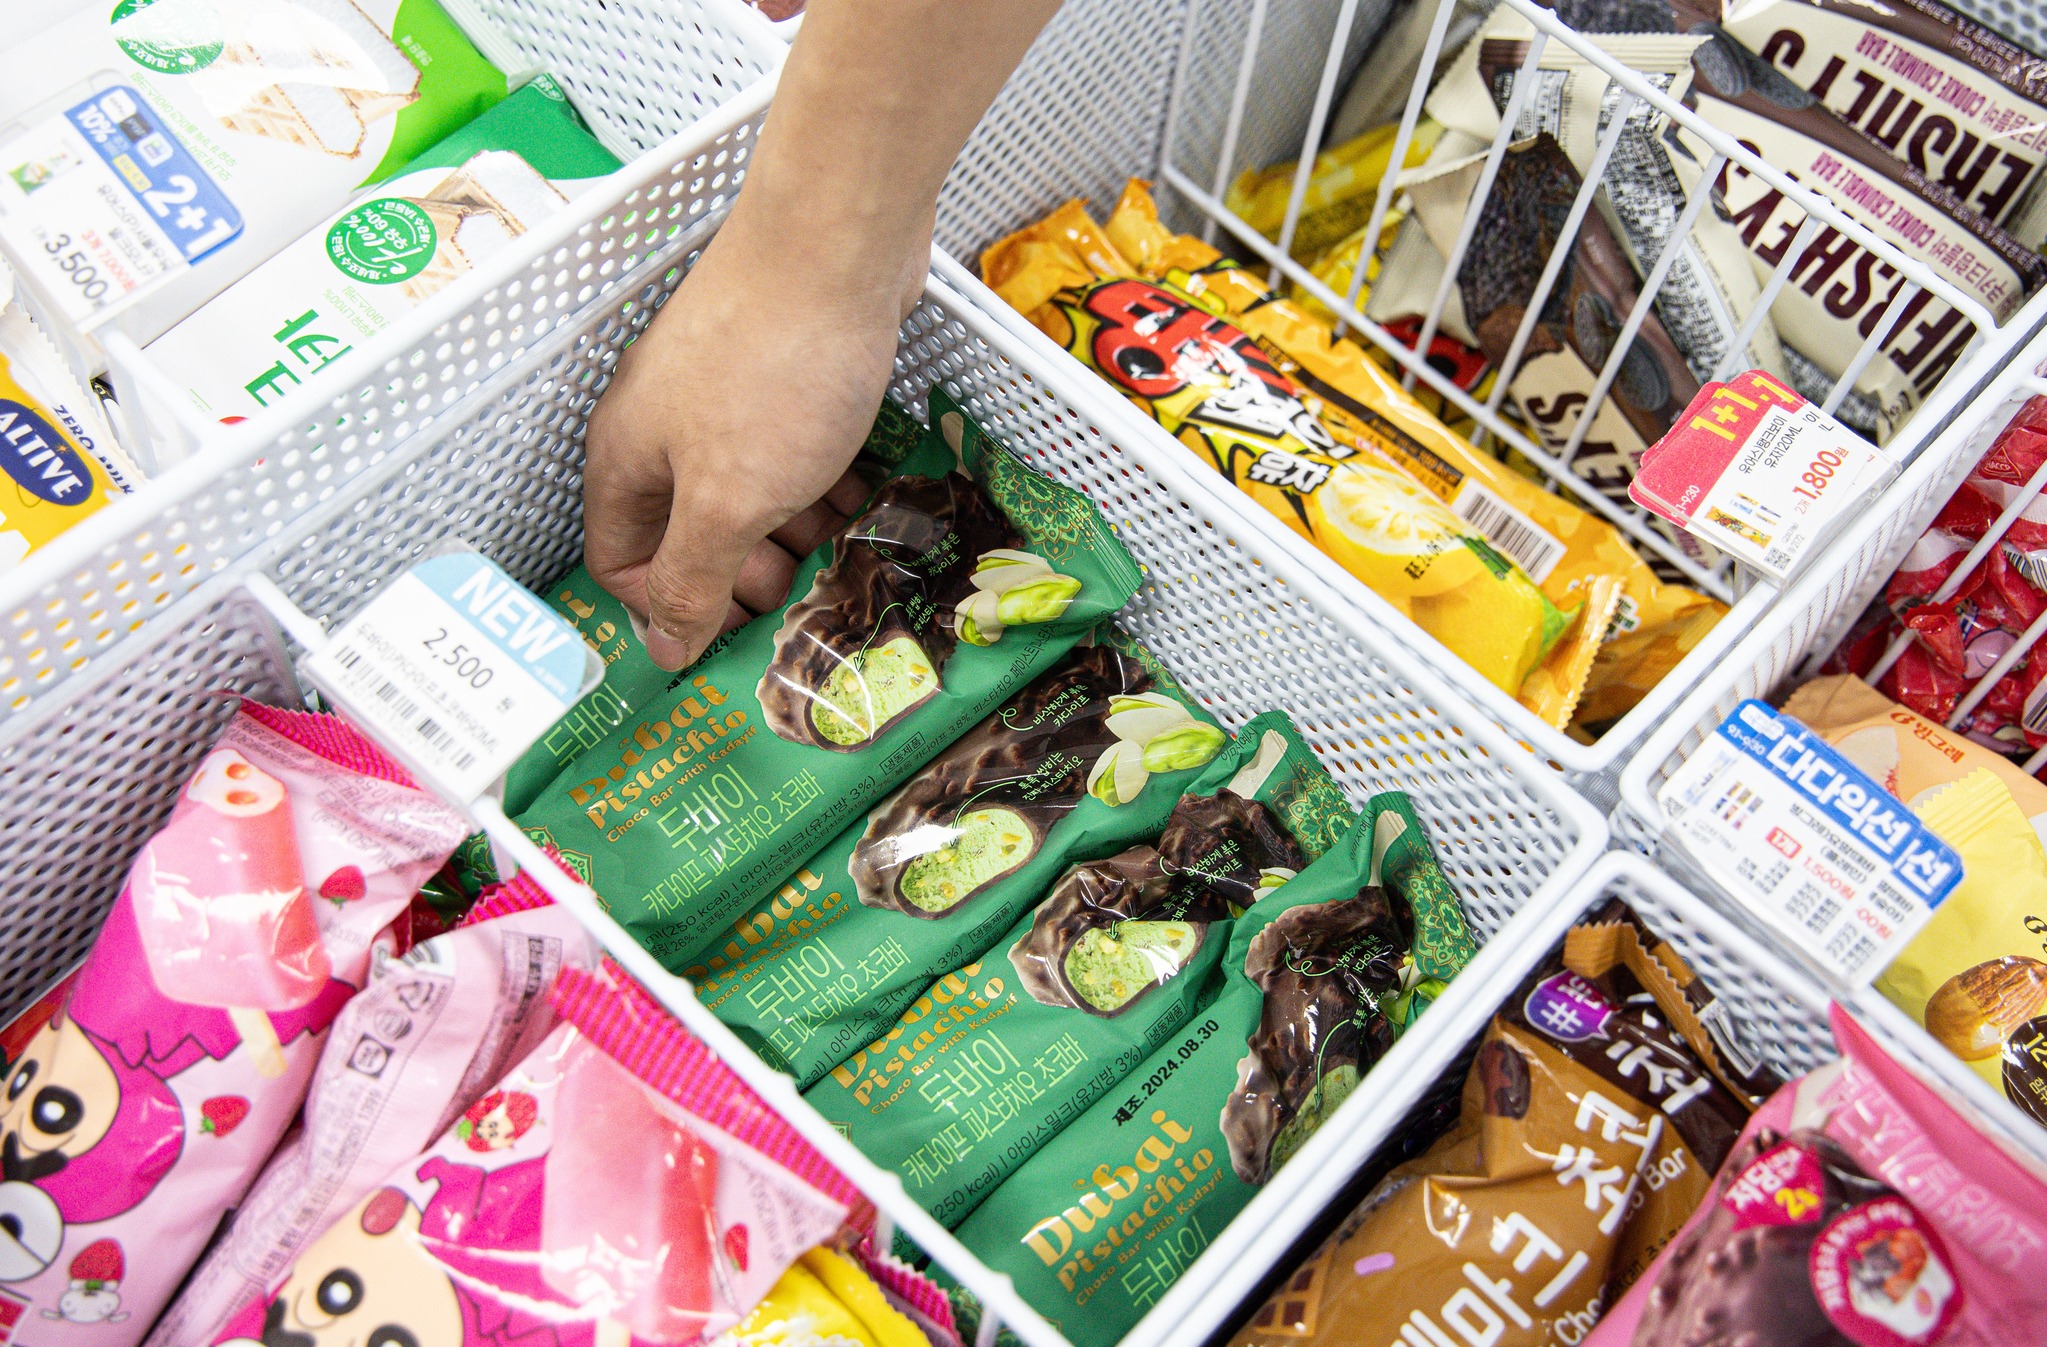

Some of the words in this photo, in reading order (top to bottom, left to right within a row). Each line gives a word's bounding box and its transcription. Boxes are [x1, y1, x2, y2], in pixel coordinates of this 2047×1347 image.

[1857, 31, 1884, 59] BAR
[1885, 48, 1938, 99] CRUMBLE
[75, 104, 116, 142] 10%
[1937, 76, 1983, 119] COOKIE
[1810, 150, 1843, 184] BAR
[1832, 167, 1896, 222] CRUMBLE
[143, 174, 233, 255] 2+1
[362, 208, 387, 231] 60%
[1885, 204, 1938, 251] COOKIE
[53, 405, 95, 452] ZERO
[1691, 387, 1757, 443] 1+1
[1736, 414, 1788, 476] 유어스)탱크보이
[1762, 421, 1803, 470] 유자120ML
[1247, 446, 1329, 495] 유자
[1793, 449, 1845, 500] 1,800원
[940, 530, 961, 553] 볶은
[452, 565, 571, 663] NEW
[421, 627, 494, 690] 2,500
[566, 675, 731, 806] Dubai
[1032, 691, 1071, 728] 바삭하게
[1052, 692, 1090, 727] 카다이프
[584, 710, 748, 830] Pistachio
[1019, 773, 1038, 793] 톡톡
[1035, 749, 1065, 778] 씹히는
[1911, 722, 1964, 766] 빙그레
[606, 808, 651, 842] Choco
[649, 782, 678, 807] Bar
[675, 758, 706, 785] with
[708, 723, 759, 766] Kadayif
[657, 762, 757, 850] 두바이
[1023, 784, 1044, 803] 진짜
[1040, 755, 1084, 793] 피스타치오
[1765, 730, 1907, 855] 다다익선
[642, 859, 713, 922] 카다이프
[700, 805, 783, 878] 피스타치오
[769, 768, 824, 821] 초코바
[697, 887, 731, 917] kcal)
[740, 793, 848, 883] 아이스밀크(유지방
[847, 774, 876, 801] 3%)
[882, 735, 923, 773] 냉동제품
[670, 927, 698, 952] 26%,
[742, 960, 769, 982] Bar
[746, 935, 845, 1021] 두바이
[784, 973, 868, 1042] 피스타치오
[857, 936, 911, 990] 초코바
[844, 978, 1011, 1107] Pistachio
[870, 1078, 912, 1115] Choco
[911, 1053, 937, 1077] Bar
[936, 1027, 968, 1055] with
[968, 992, 1019, 1031] Kadayif
[918, 1029, 1019, 1114] 두바이
[1112, 1018, 1219, 1127] 제조.2024.08.30
[903, 1123, 974, 1193] 카다이프
[962, 1071, 1045, 1145] 피스타치오
[1033, 1033, 1088, 1088] 초코바
[961, 1160, 1001, 1197] kcal)
[1005, 1065, 1117, 1160] 아이스밀크(유지방
[1112, 1043, 1145, 1073] 3%)
[1148, 1003, 1184, 1042] 냉동제품
[1021, 1109, 1193, 1268] Dubai
[1549, 1091, 1664, 1232] 초코
[1643, 1147, 1688, 1192] Bar
[1054, 1145, 1214, 1294] Pistachio
[1075, 1267, 1117, 1306] Choco
[1115, 1238, 1145, 1266] Bar
[1141, 1211, 1175, 1243] with
[1173, 1169, 1228, 1215] Kadayif
